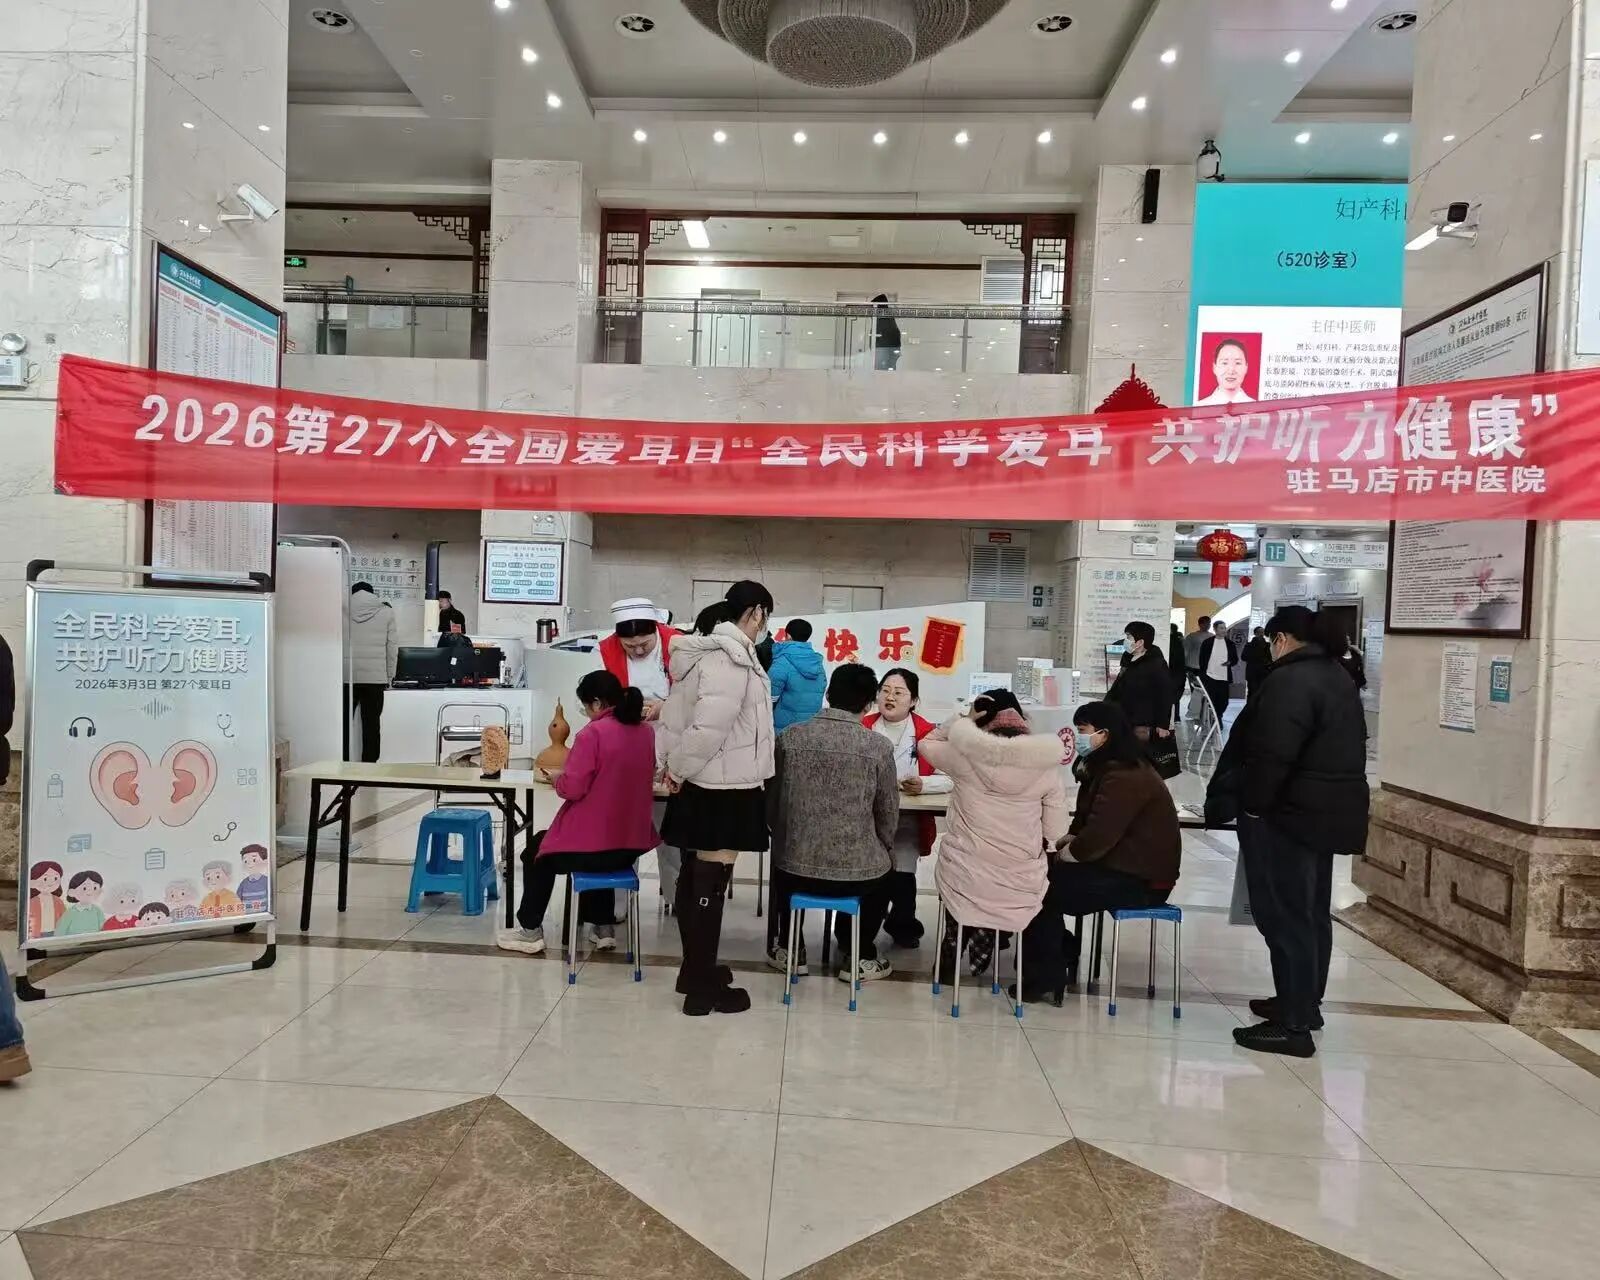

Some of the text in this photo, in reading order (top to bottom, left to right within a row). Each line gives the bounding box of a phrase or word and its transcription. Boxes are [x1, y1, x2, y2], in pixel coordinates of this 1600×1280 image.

[1336, 197, 1408, 221] 妇产科
[1276, 251, 1357, 269] （520诊室）
[1312, 319, 1377, 334] 主任中医师
[1286, 466, 1546, 495] 驻马店市中医院
[1269, 546, 1284, 559] 1F
[56, 643, 248, 673] 共护听力健康
[75, 678, 231, 690] 2026年3月3日 第27个爱耳日
